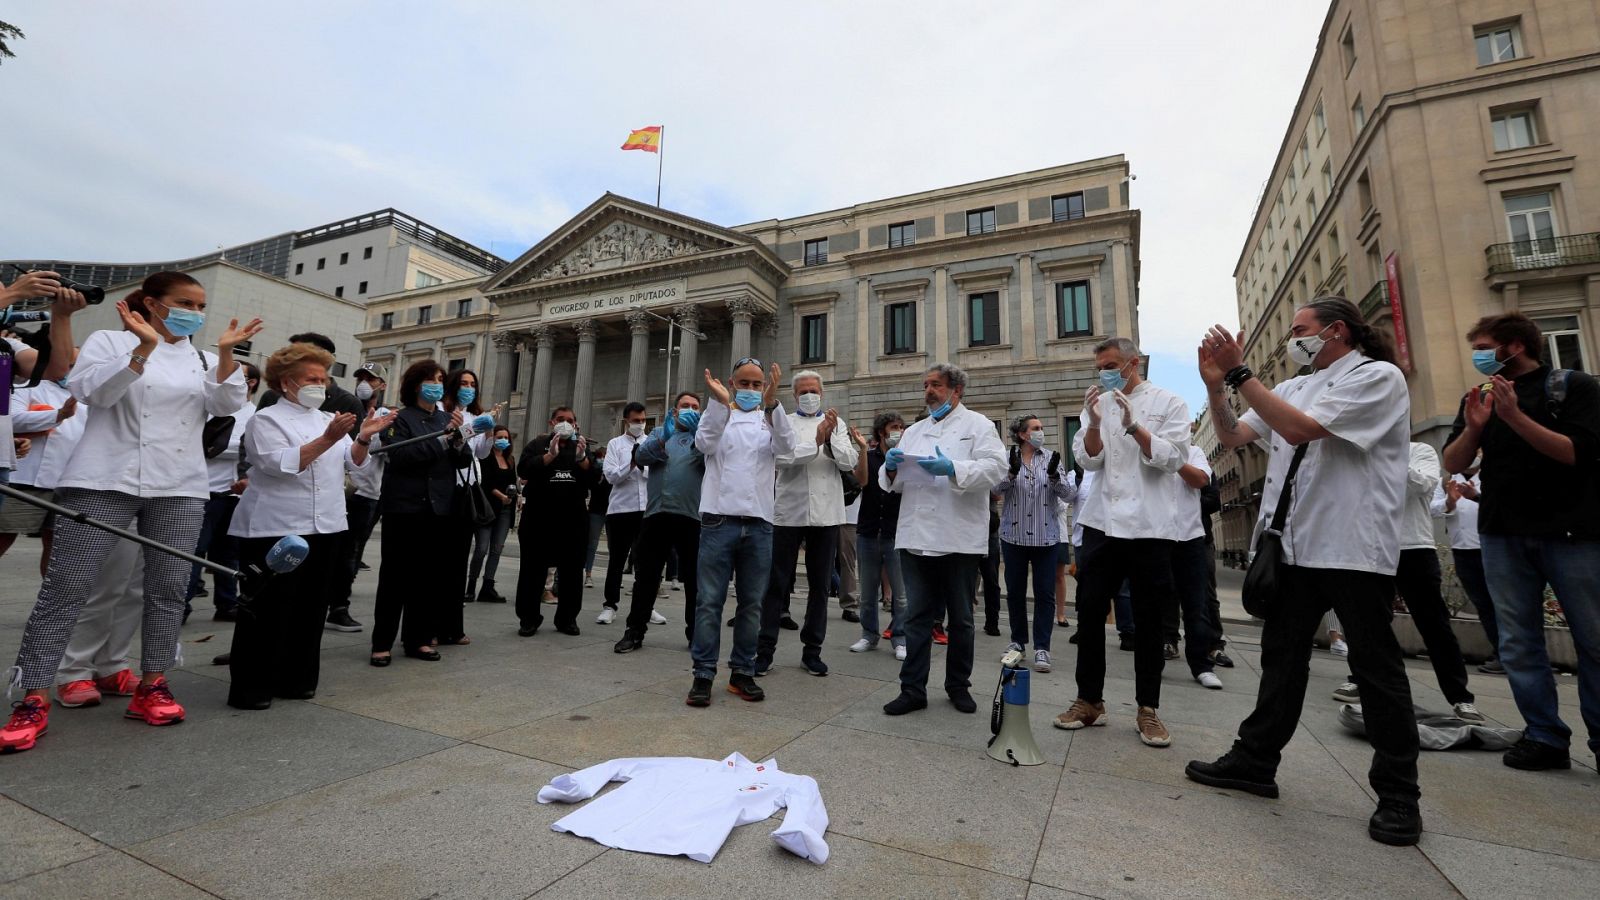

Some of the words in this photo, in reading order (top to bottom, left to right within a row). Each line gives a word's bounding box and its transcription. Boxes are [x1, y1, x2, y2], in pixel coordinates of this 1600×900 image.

[550, 301, 589, 315] CONGRESO
[594, 299, 604, 309] DE
[609, 296, 624, 306] LOS
[629, 287, 677, 304] DIPUTADOS
[284, 553, 301, 566] tve
